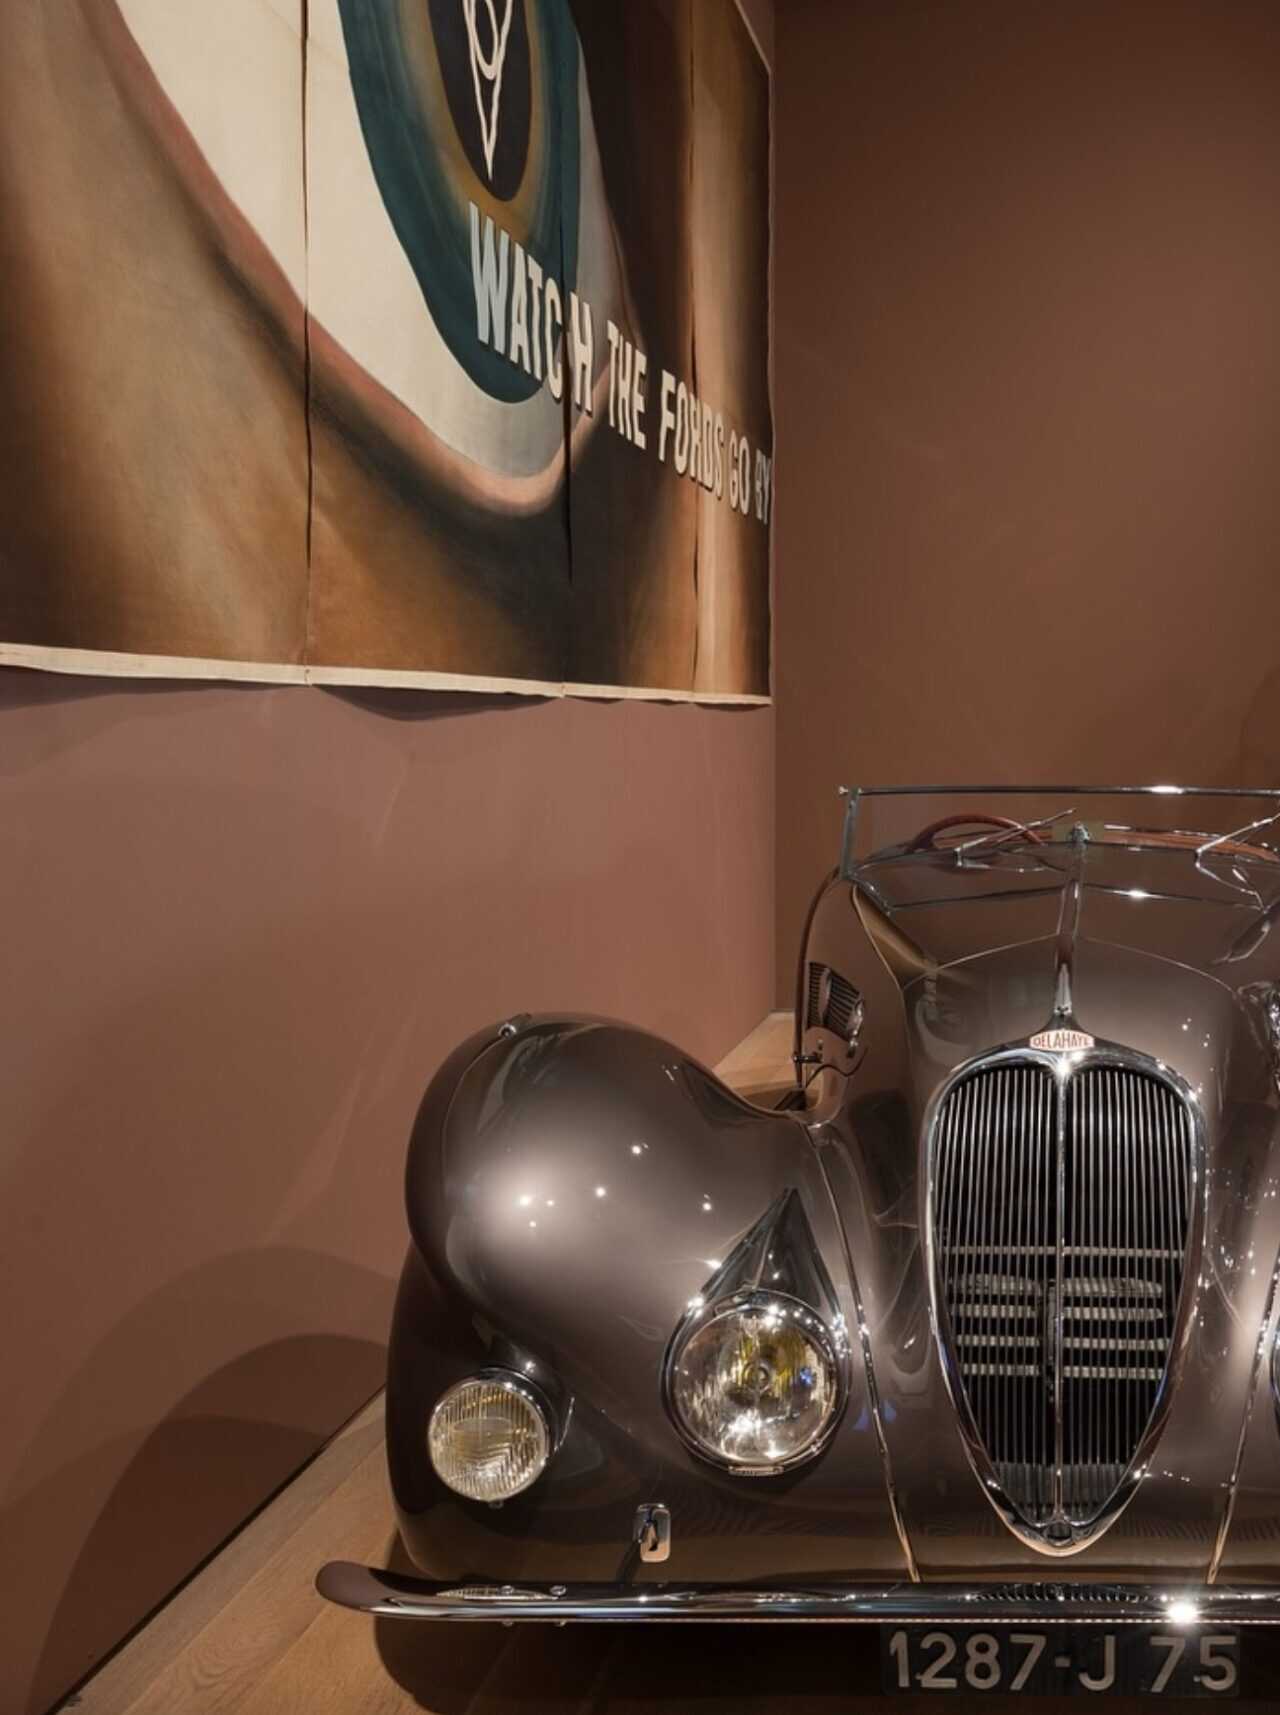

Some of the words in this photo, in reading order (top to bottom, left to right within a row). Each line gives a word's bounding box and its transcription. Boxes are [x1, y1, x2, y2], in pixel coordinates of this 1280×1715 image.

[469, 201, 593, 414] WATCH
[607, 320, 648, 450] THE
[659, 369, 725, 501] FORDS
[729, 429, 750, 516] GO
[755, 448, 772, 525] BY
[1033, 1032, 1089, 1049] DELAHAYE
[1150, 1635, 1237, 1693] 75
